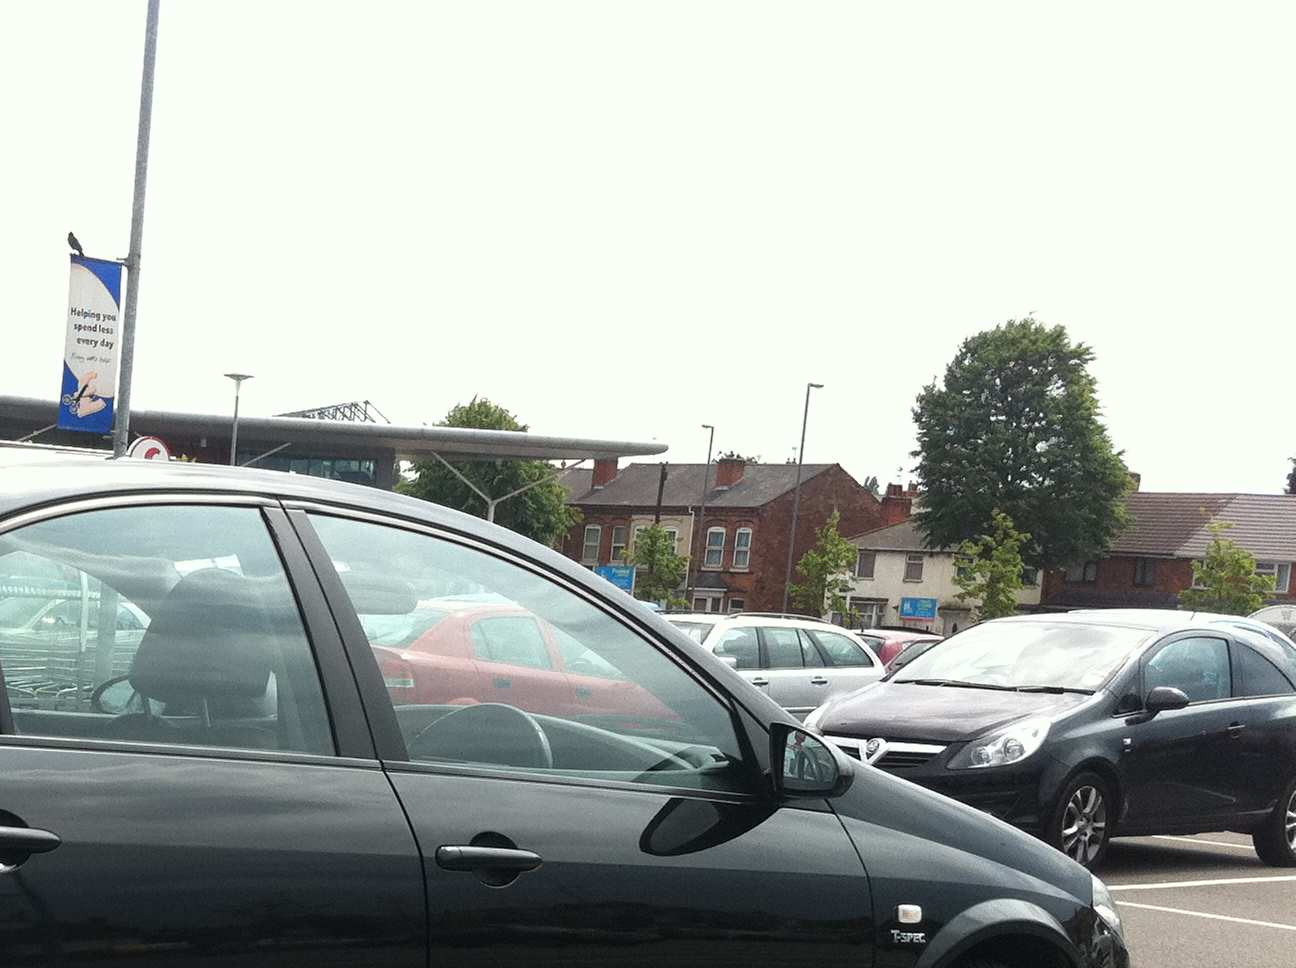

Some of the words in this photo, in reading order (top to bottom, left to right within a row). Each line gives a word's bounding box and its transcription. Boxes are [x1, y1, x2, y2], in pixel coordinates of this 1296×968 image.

[70, 306, 101, 321] Helping
[102, 313, 117, 322] you
[74, 323, 97, 332] spend
[99, 324, 114, 335] less
[76, 337, 99, 348] every
[100, 338, 115, 350] day
[890, 929, 927, 943] T-SPEC
